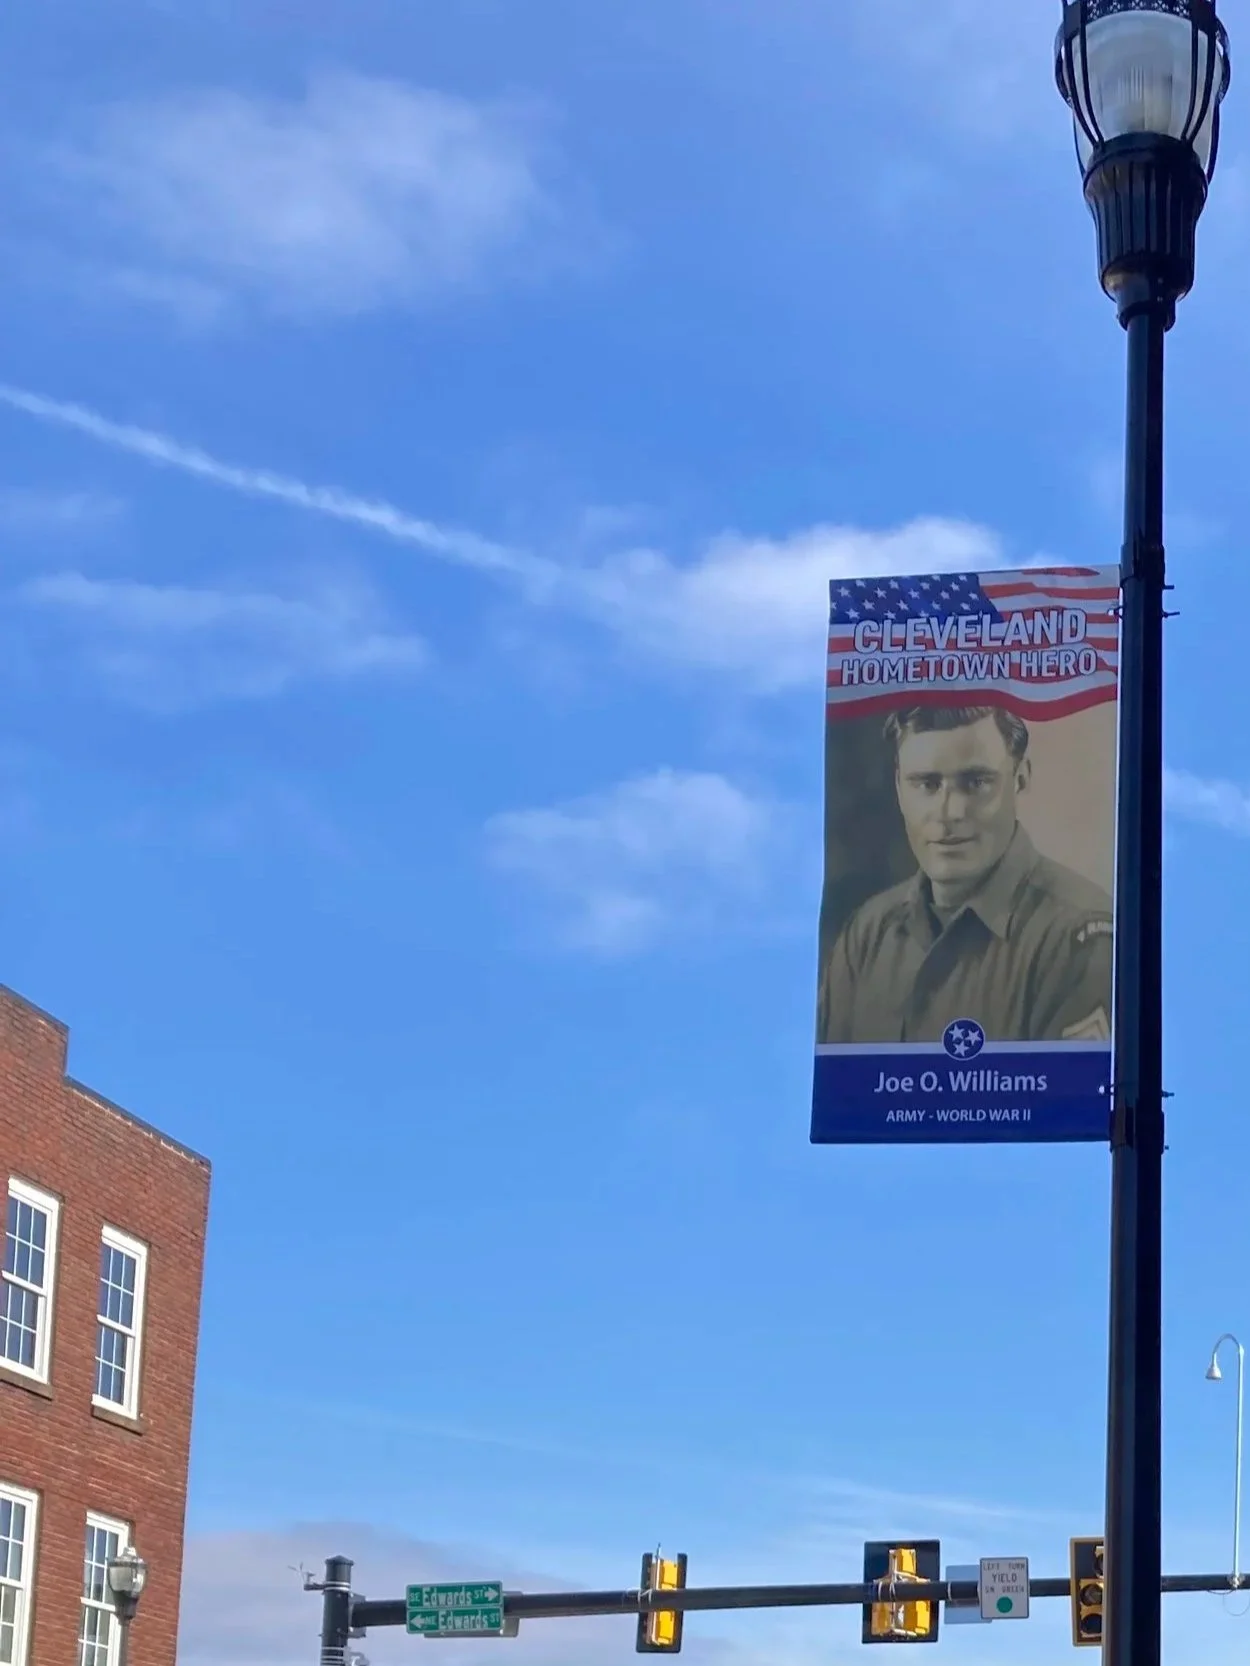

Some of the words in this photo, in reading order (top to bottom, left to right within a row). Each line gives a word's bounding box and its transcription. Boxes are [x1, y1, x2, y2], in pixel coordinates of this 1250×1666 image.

[854, 608, 1087, 654] CLEVELAND
[841, 652, 1011, 685] HOMETOWN
[1020, 647, 1097, 677] HERO
[874, 1072, 913, 1093] Joe
[920, 1071, 943, 1092] O.
[949, 1070, 1048, 1092] Williams
[886, 1110, 925, 1122] ARMY
[936, 1109, 986, 1122] WORLD
[988, 1109, 1019, 1121] WAR
[1023, 1109, 1031, 1121] II
[992, 1573, 1017, 1583] YIELD
[423, 1587, 472, 1607] Edwards
[439, 1610, 489, 1630] Edwards
